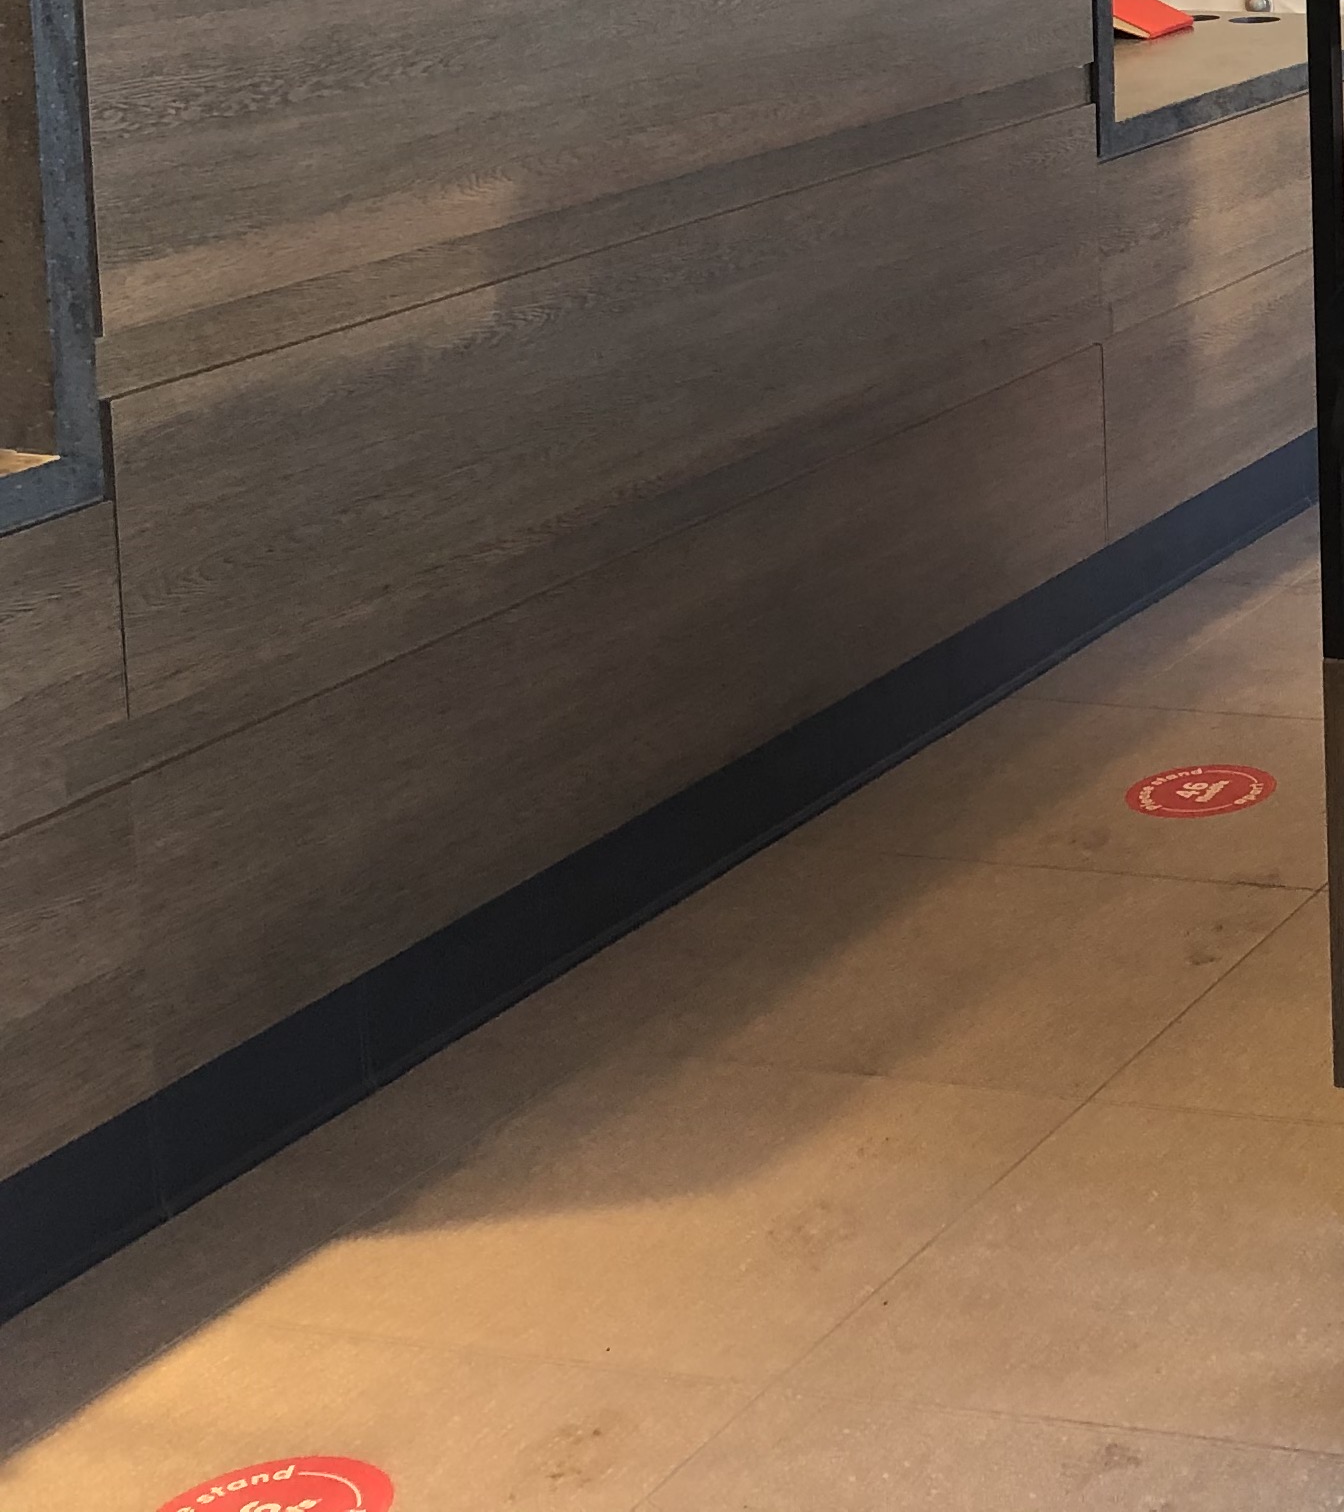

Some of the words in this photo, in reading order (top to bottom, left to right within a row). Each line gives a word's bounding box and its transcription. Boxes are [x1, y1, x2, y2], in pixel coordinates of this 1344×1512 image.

[1151, 767, 1203, 786] stand
[1176, 782, 1209, 799] 46
[196, 1464, 296, 1504] stand
